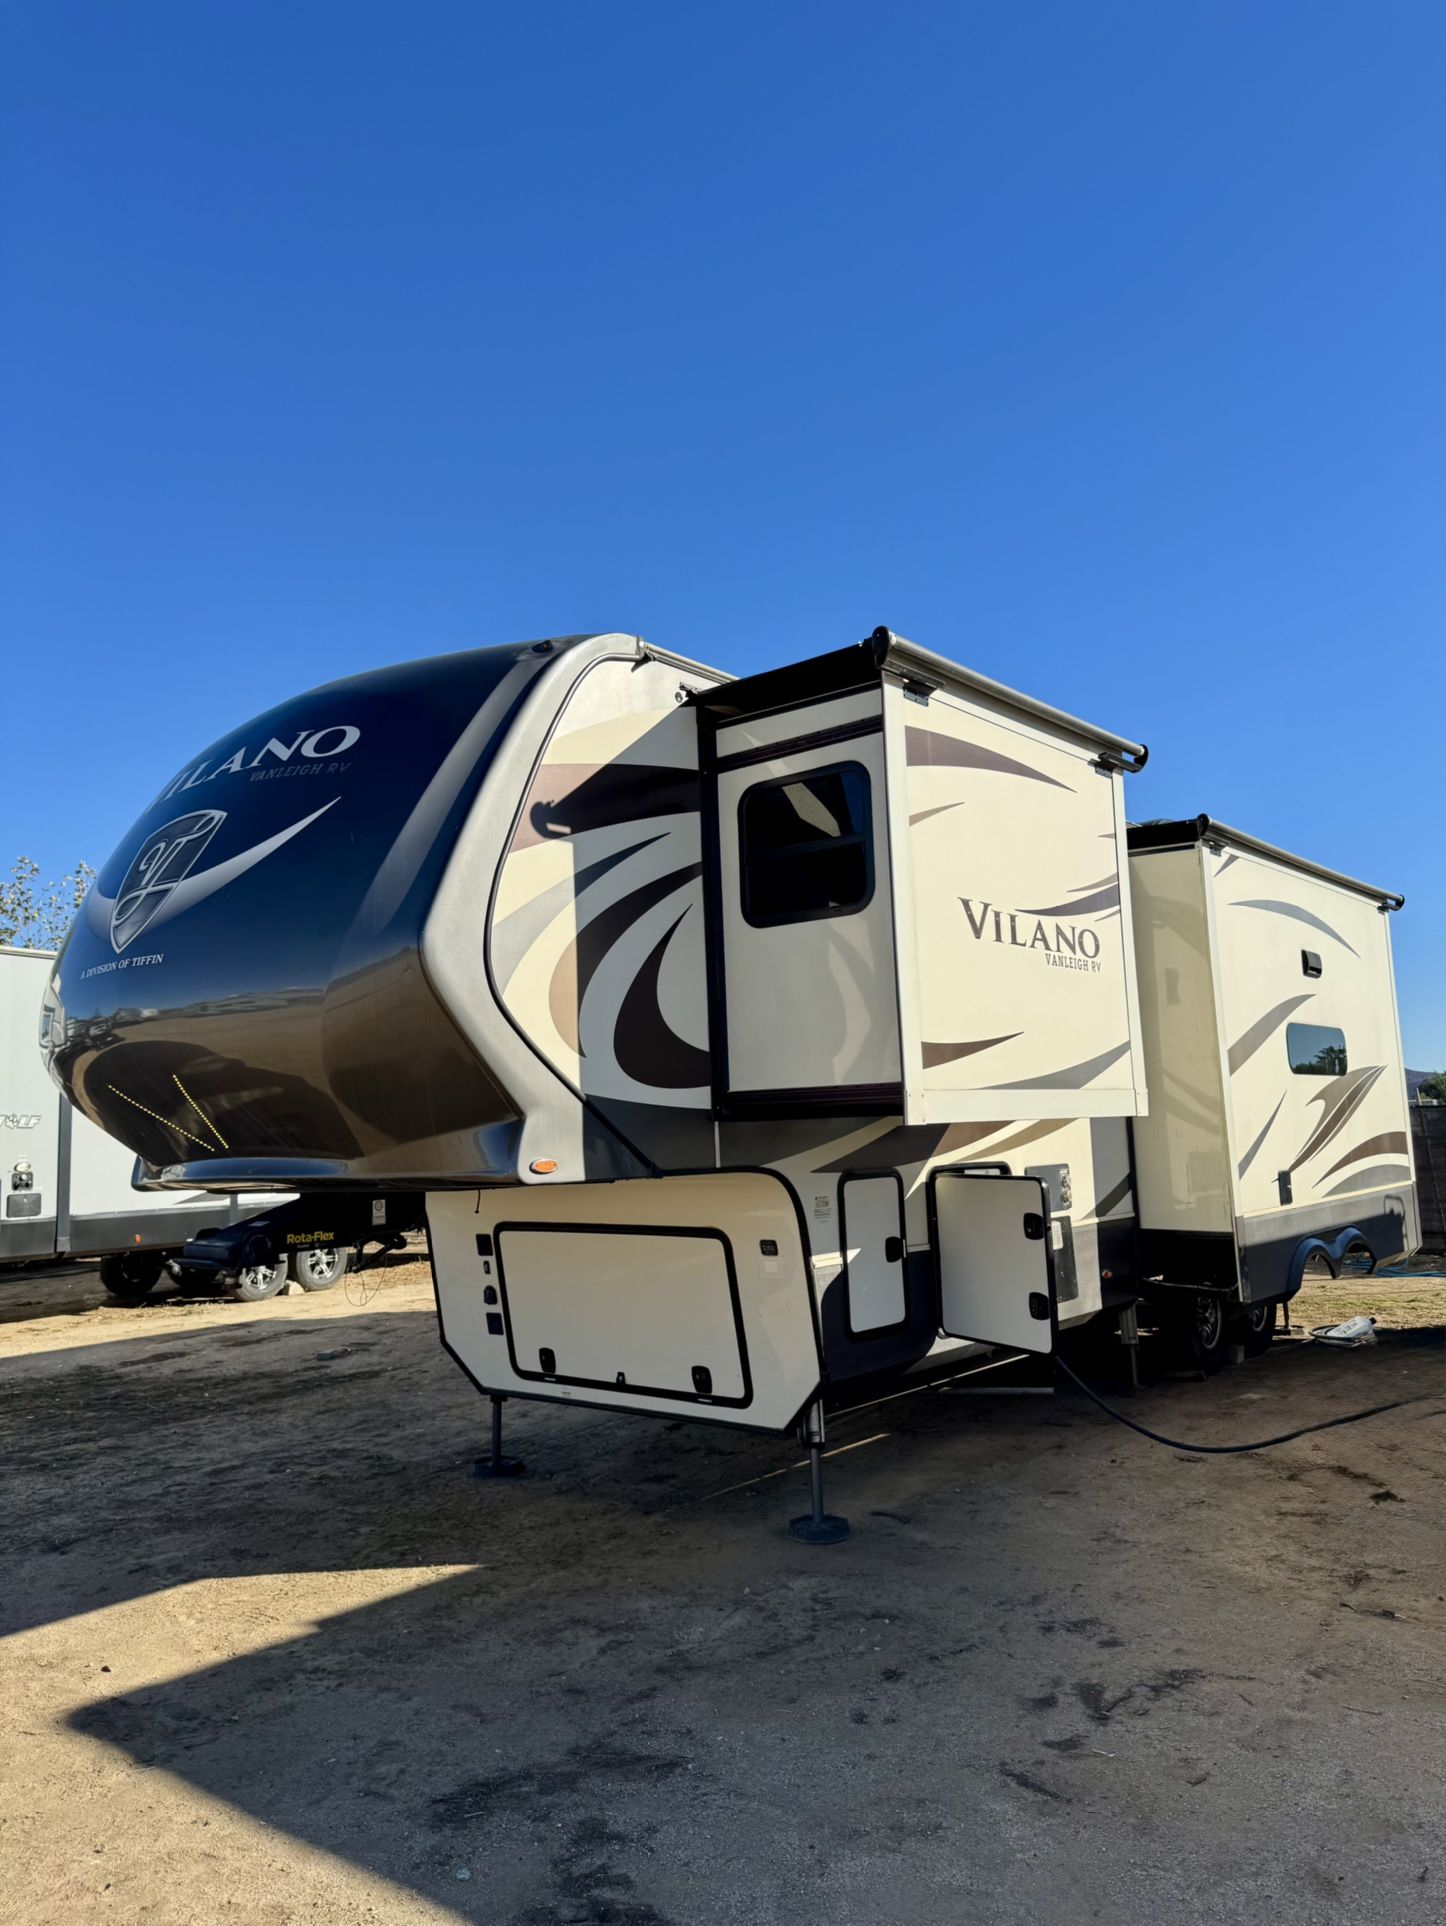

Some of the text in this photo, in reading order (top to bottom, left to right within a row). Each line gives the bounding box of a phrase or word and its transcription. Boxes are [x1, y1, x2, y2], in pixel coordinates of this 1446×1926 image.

[249, 762, 352, 782] VANLEIGH RV
[957, 896, 1100, 959] VILANO
[80, 954, 164, 980] A DIVISION OF TIFFIN
[1045, 953, 1101, 973] VANLEIGH RV
